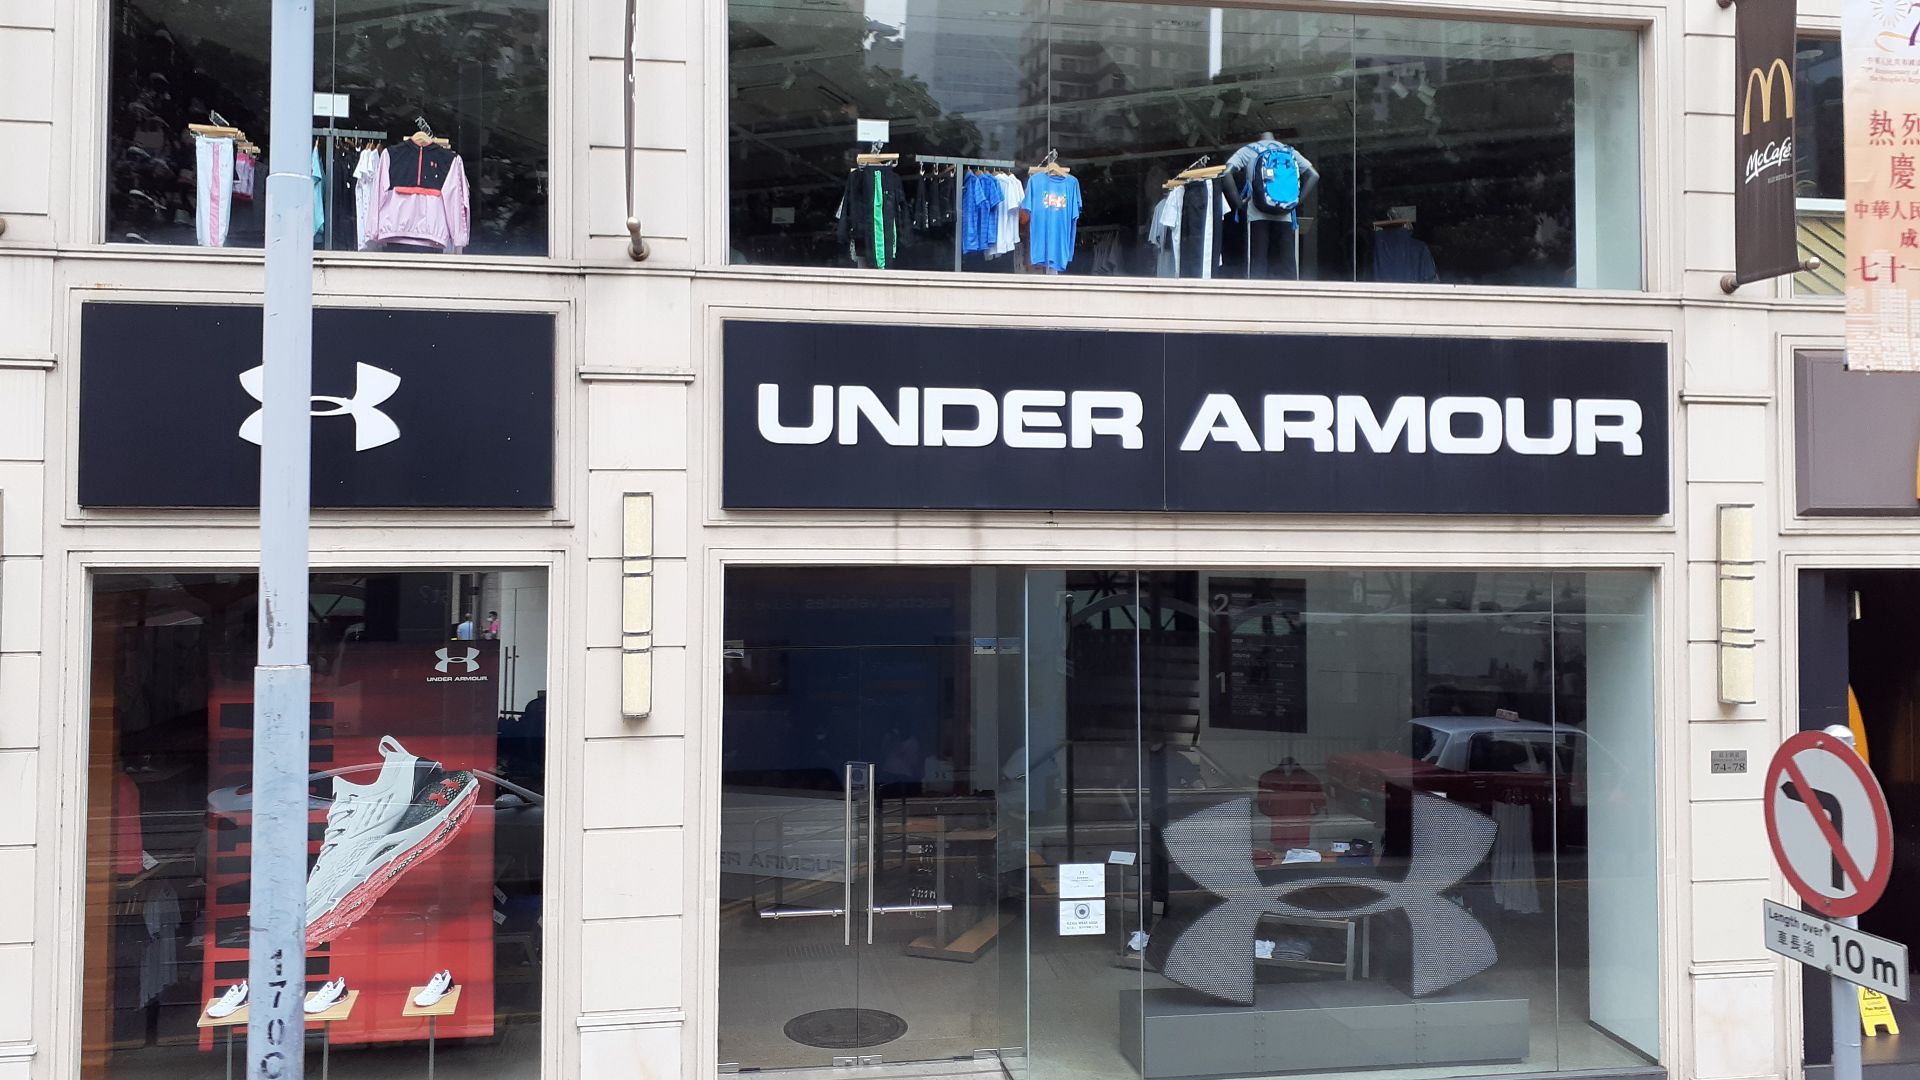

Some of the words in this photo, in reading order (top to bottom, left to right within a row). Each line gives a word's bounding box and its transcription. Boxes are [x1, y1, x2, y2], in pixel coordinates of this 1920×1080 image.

[758, 383, 1143, 450] UNDER
[1179, 393, 1643, 456] ARMOUR
[1768, 907, 1800, 929] Length
[1802, 922, 1824, 937] over
[1831, 935, 1865, 975] 10
[1872, 956, 1898, 987] m
